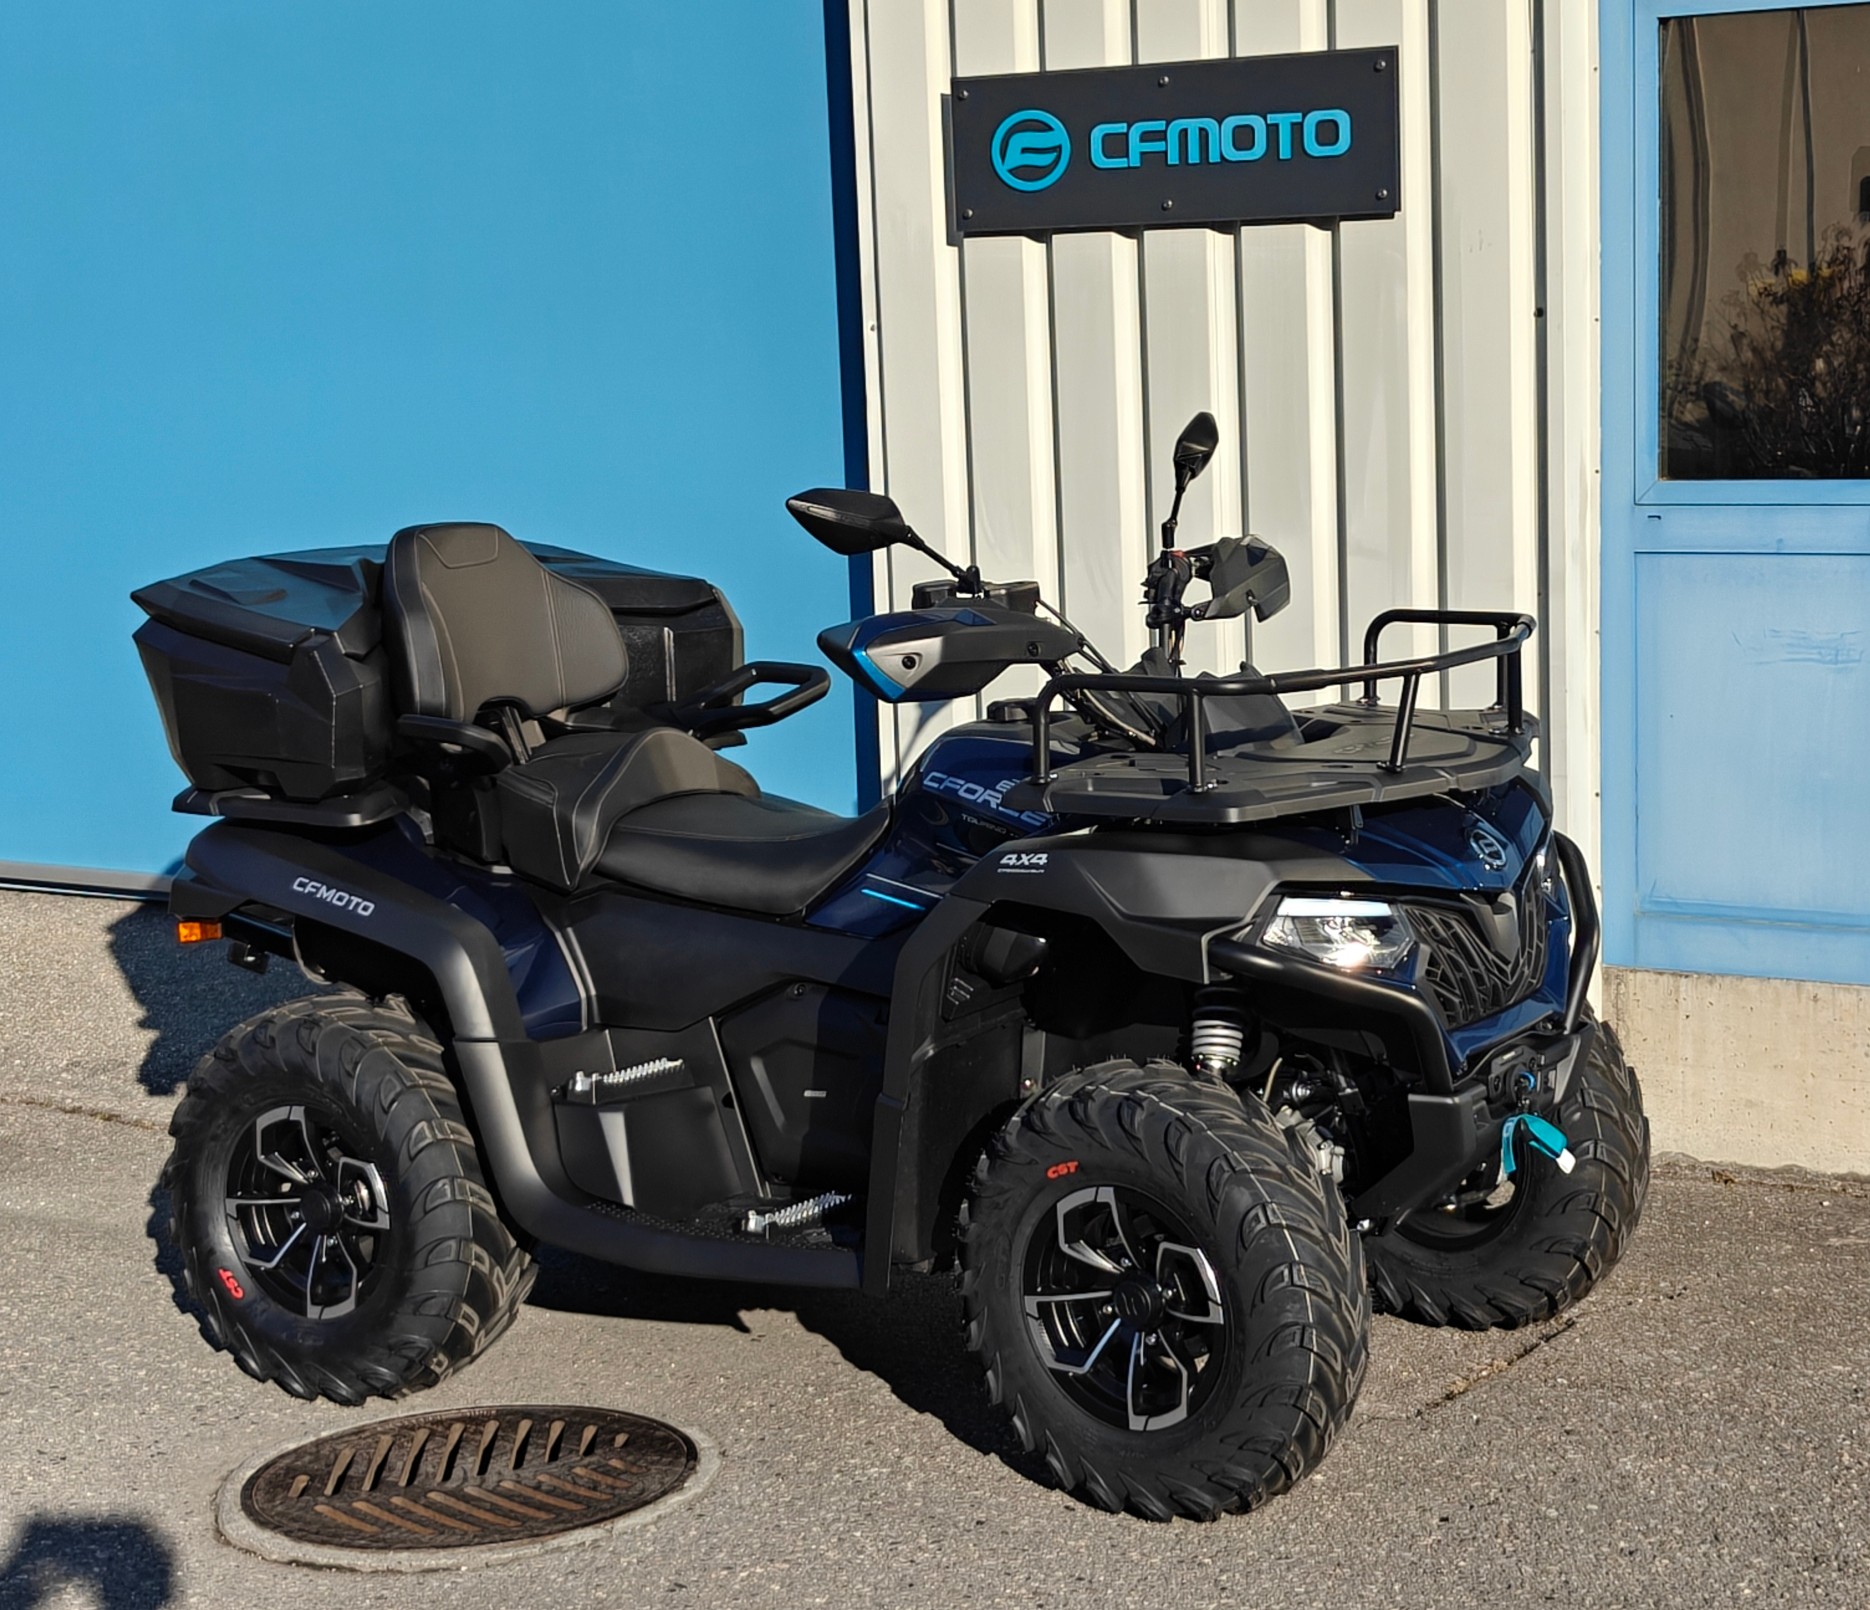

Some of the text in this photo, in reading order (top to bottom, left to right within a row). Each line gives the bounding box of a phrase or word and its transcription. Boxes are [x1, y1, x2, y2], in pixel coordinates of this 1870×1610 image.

[1089, 108, 1352, 169] CFMOTO
[922, 771, 1052, 827] CFORE
[292, 876, 375, 917] CFMOTO
[1047, 1161, 1079, 1179] CST
